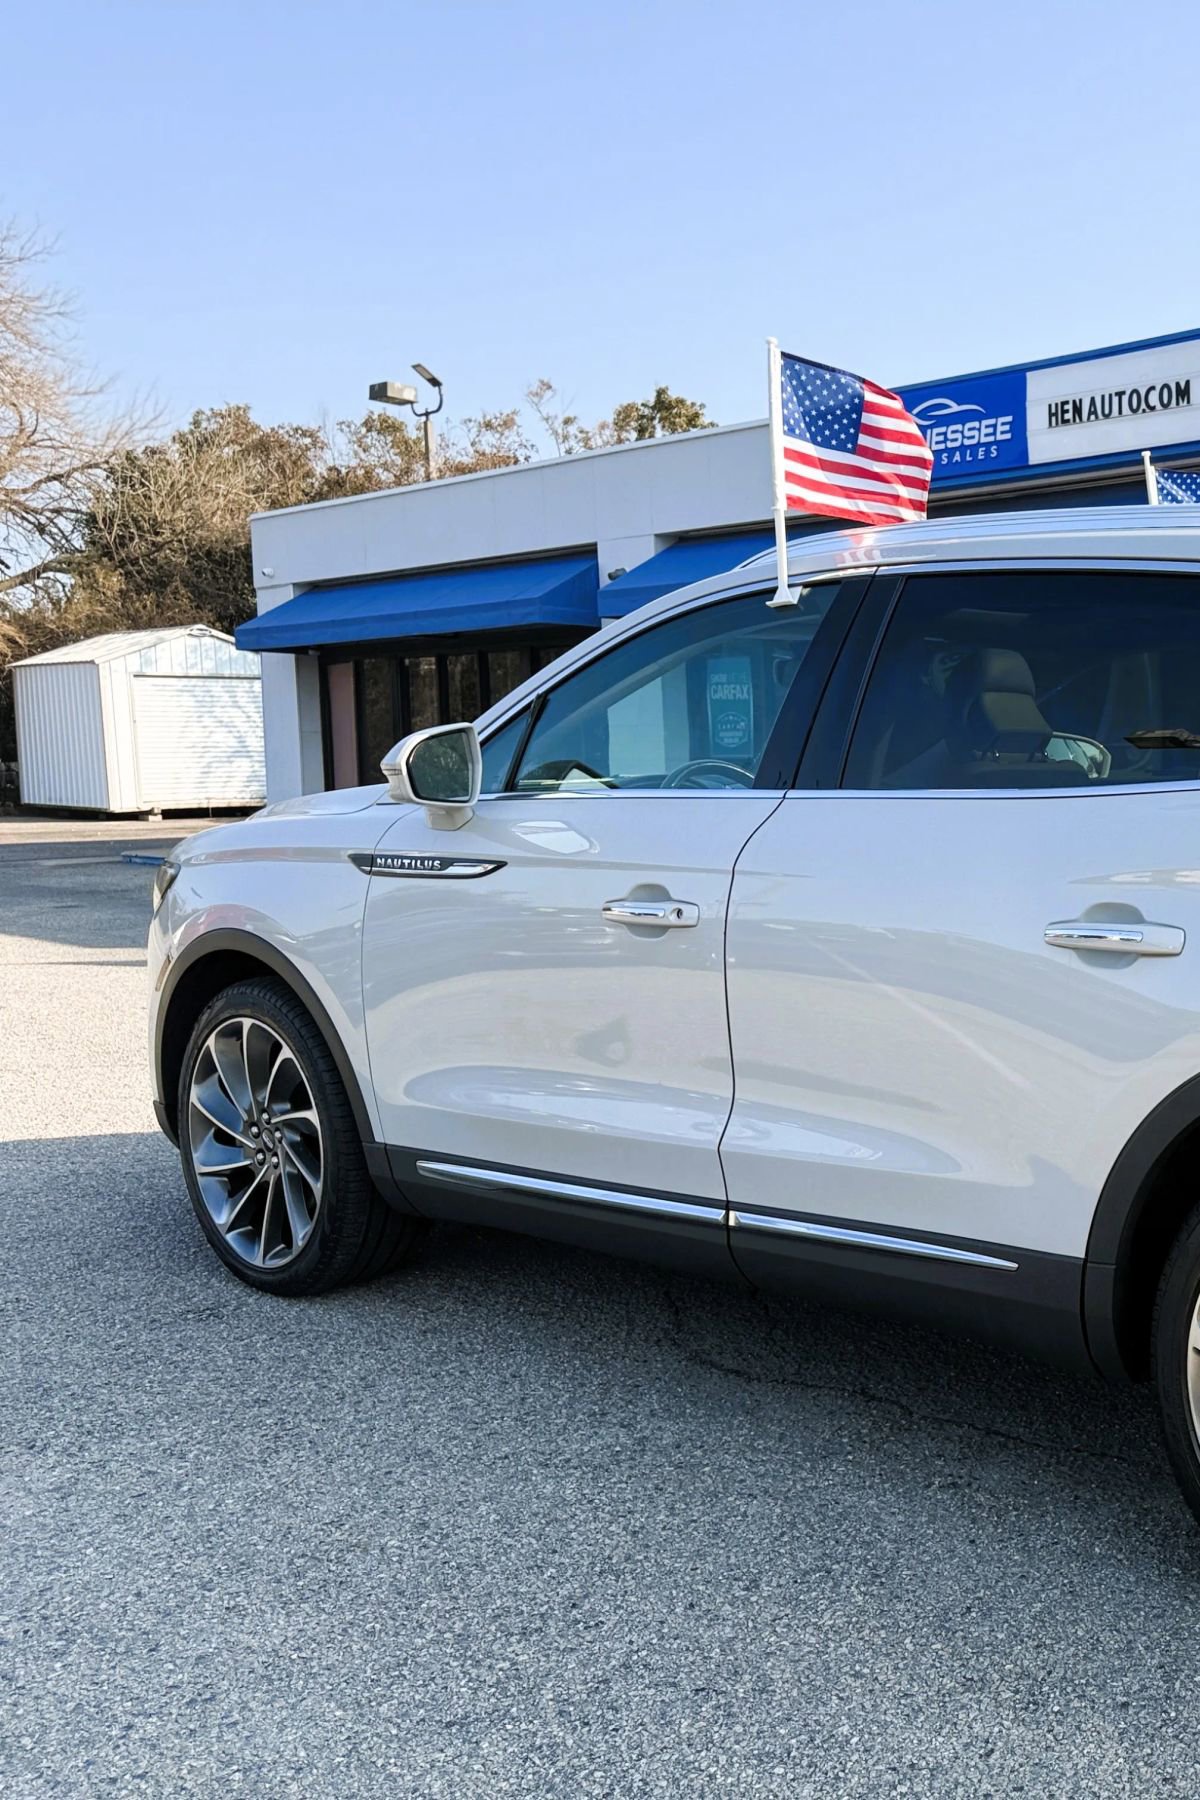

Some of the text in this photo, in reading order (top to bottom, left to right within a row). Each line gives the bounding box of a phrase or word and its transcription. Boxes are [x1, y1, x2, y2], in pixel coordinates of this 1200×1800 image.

[941, 445, 998, 465] SALES
[711, 684, 749, 700] CARFAX
[376, 857, 441, 870] NAUTILUS
